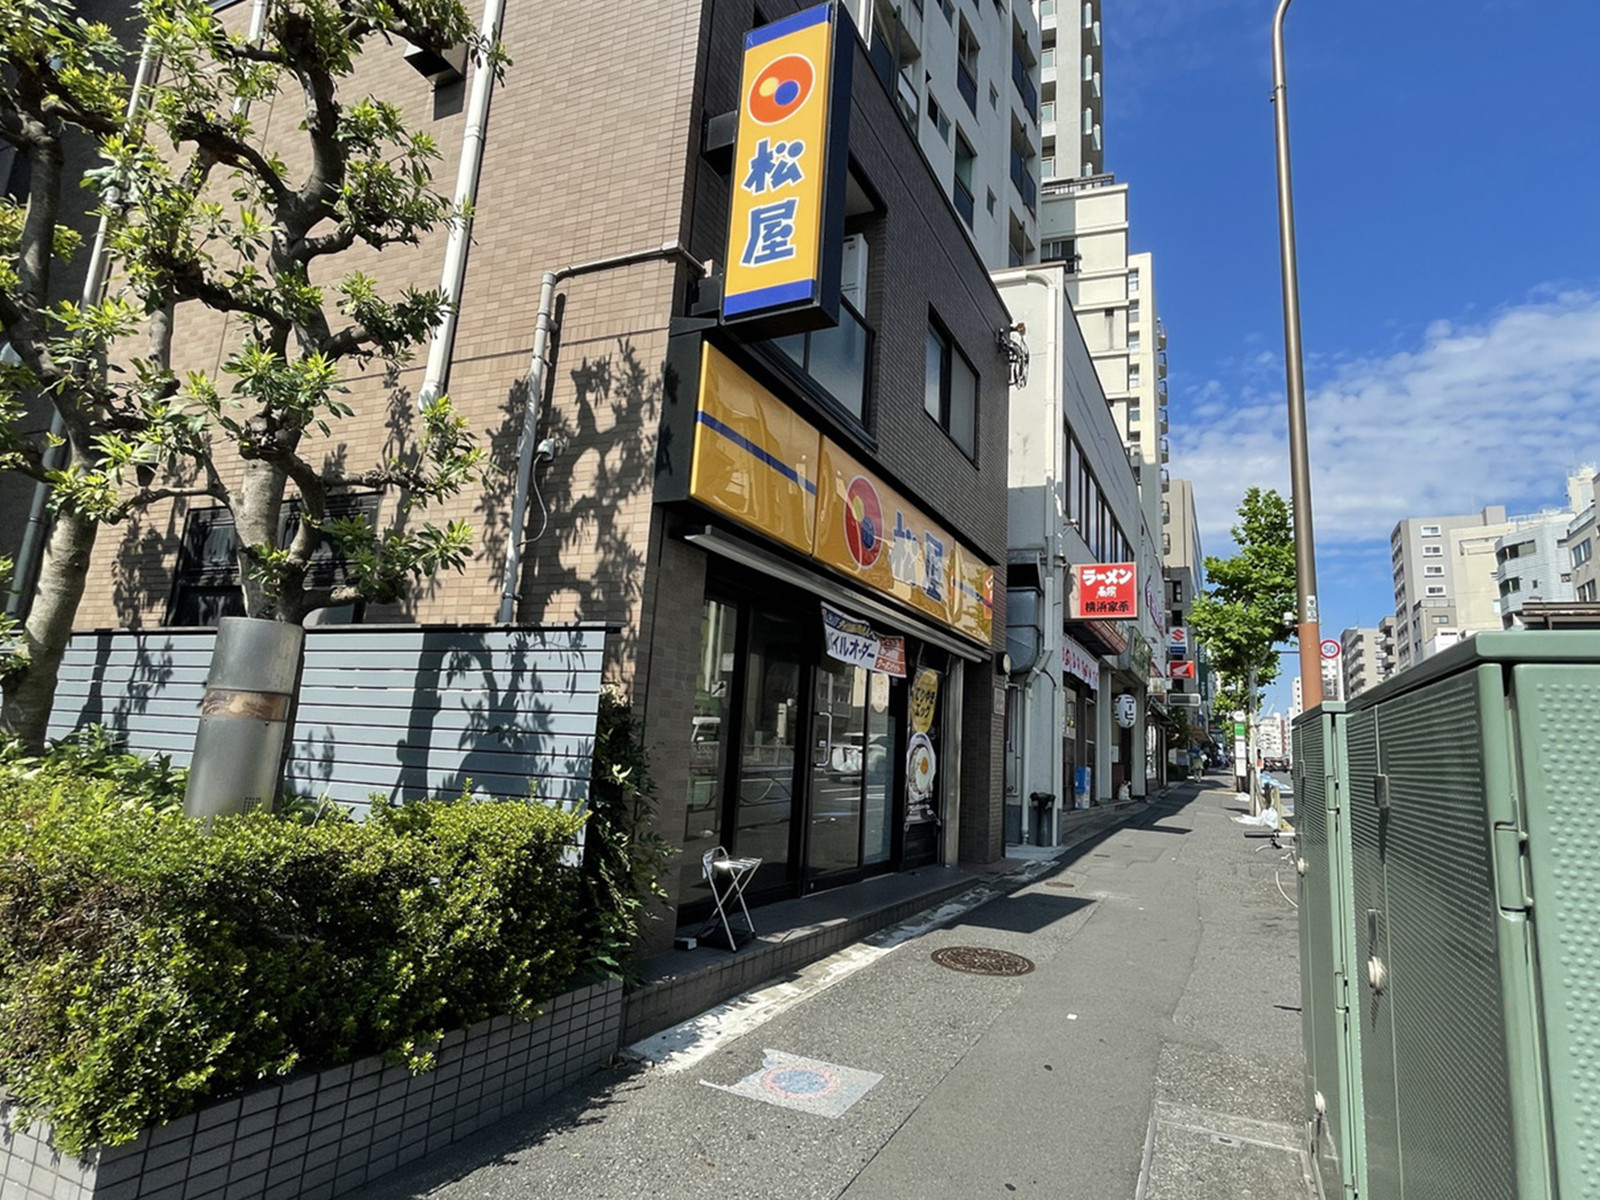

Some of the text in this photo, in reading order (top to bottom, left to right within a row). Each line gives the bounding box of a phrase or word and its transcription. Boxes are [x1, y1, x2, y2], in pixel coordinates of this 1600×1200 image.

[740, 136, 805, 268] 松屋
[1082, 569, 1133, 586] ラーメン
[1085, 601, 1129, 613] 横浜家系
[1323, 644, 1336, 654] 50
